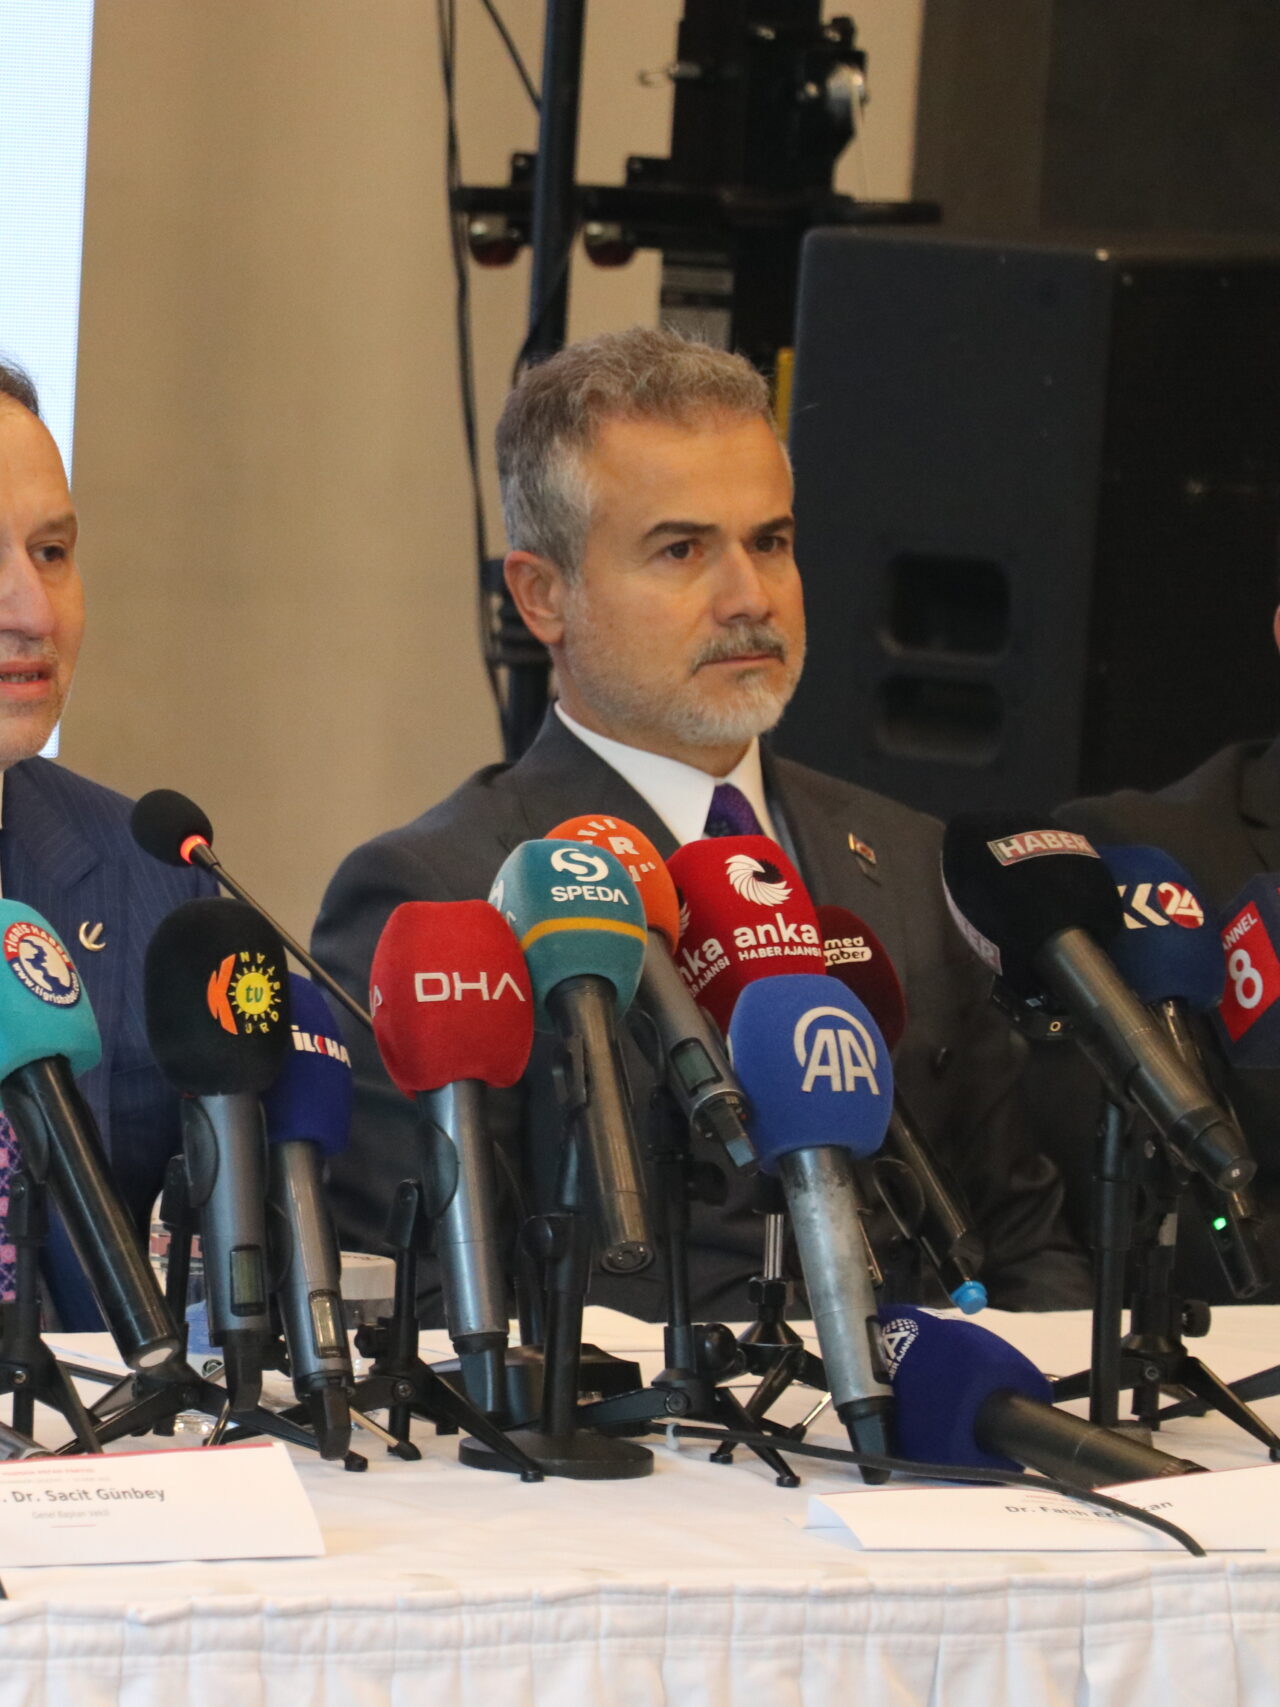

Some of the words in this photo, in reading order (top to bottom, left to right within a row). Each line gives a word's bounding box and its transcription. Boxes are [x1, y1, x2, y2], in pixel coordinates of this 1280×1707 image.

[997, 832, 1092, 859] HABER
[550, 885, 630, 906] SPEDA
[732, 912, 820, 949] anka
[824, 936, 864, 950] med
[737, 946, 783, 962] HABER
[414, 971, 527, 1003] DHA
[1228, 948, 1264, 1010] 8
[801, 1028, 881, 1096] AA
[11, 1490, 41, 1504] Dr.
[44, 1488, 91, 1503] Sacit
[95, 1486, 166, 1504] Günbey
